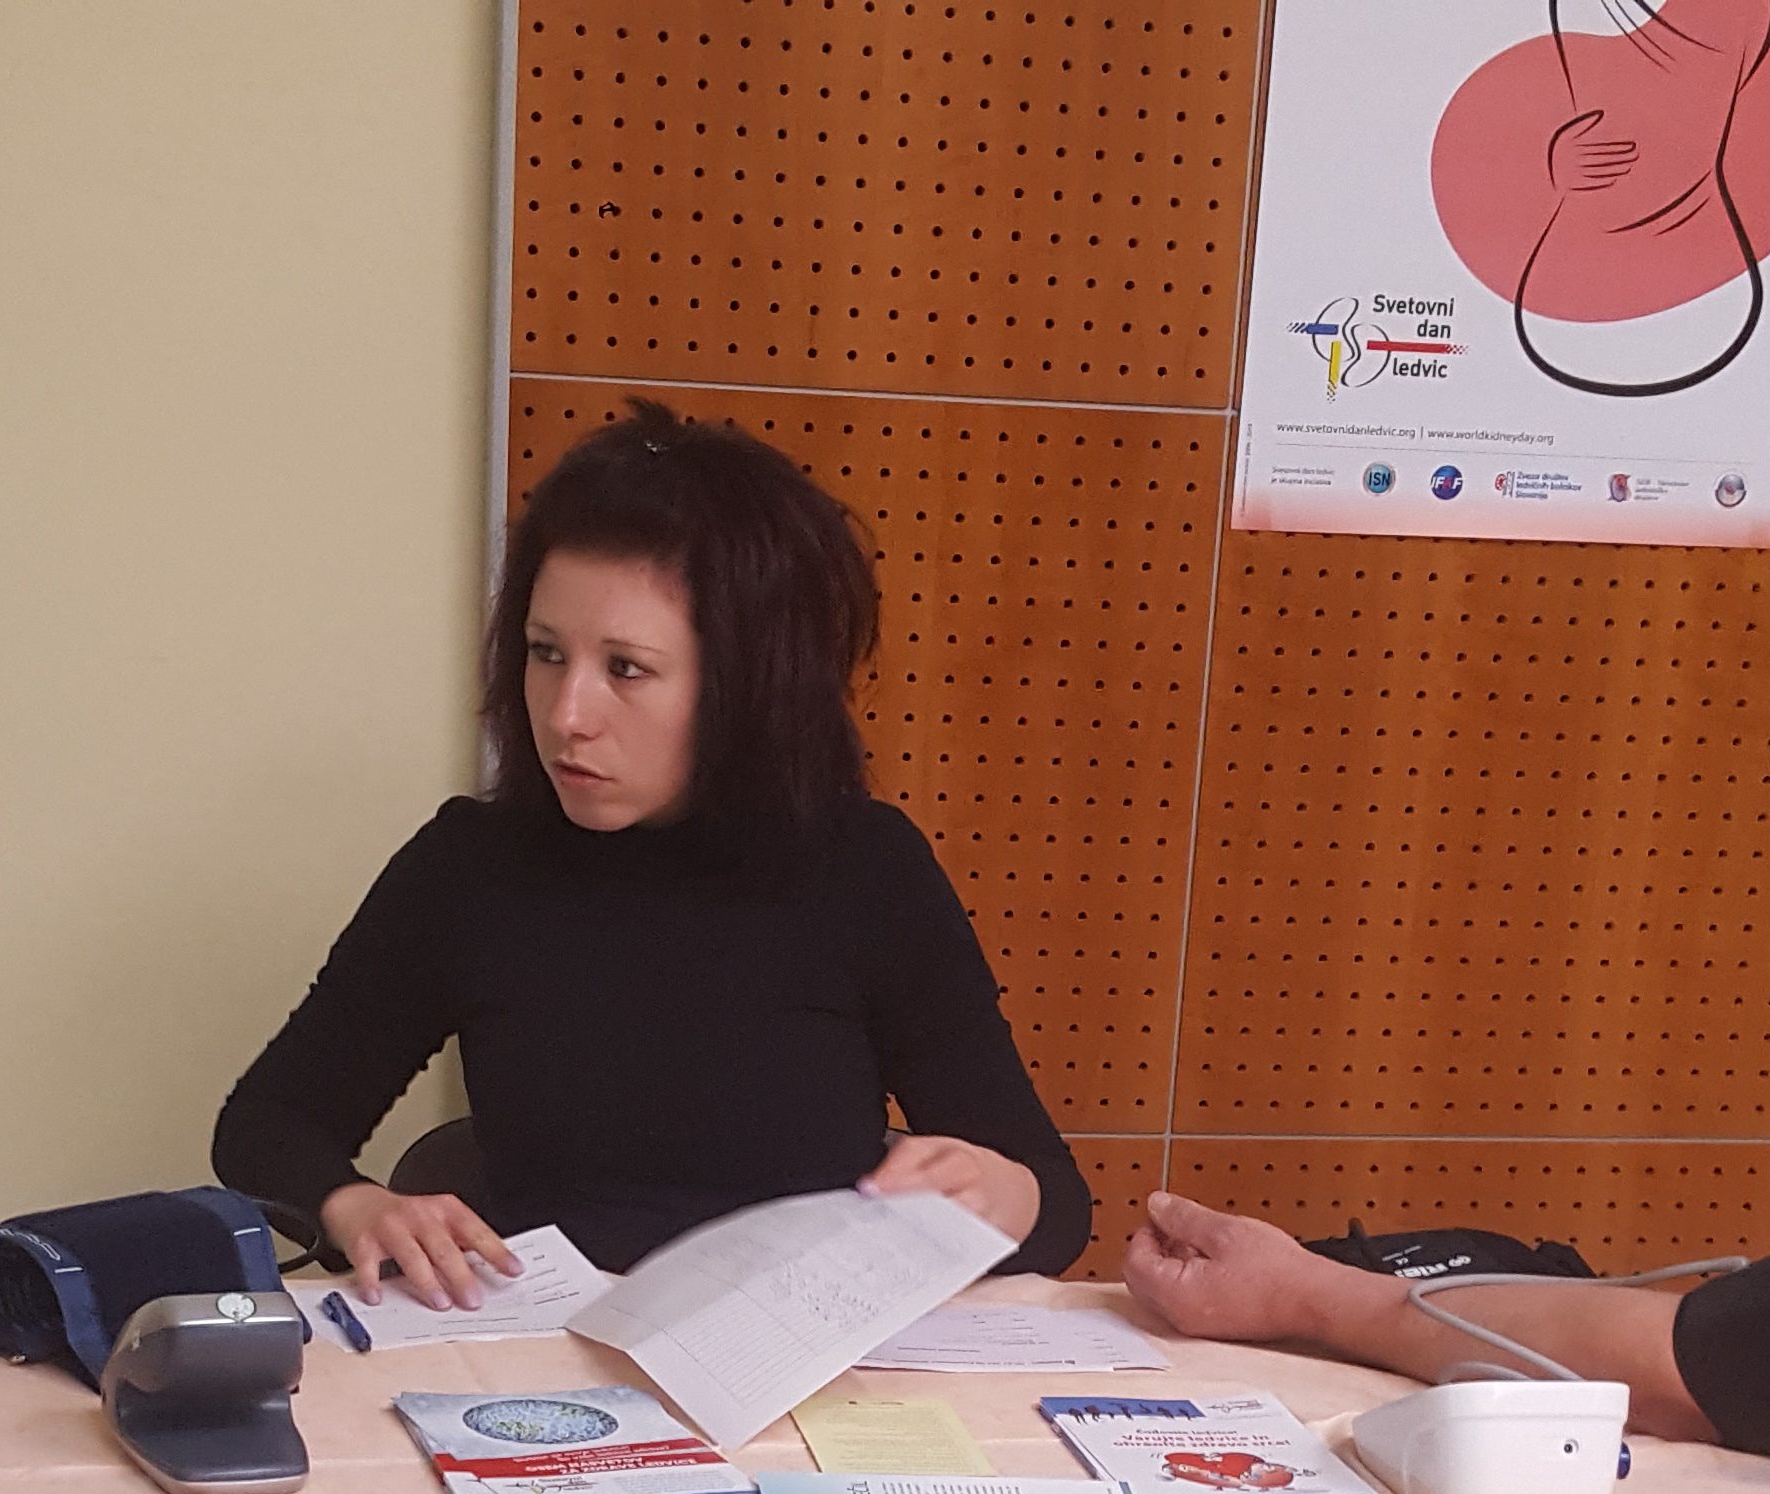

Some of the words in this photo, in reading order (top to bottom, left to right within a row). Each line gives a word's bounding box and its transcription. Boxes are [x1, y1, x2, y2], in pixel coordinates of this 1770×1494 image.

[1373, 294, 1455, 317] Svetovni
[1417, 319, 1451, 338] dan
[1392, 358, 1448, 378] ledvic
[1277, 423, 1416, 439] www.svetovnidanledvic.org
[1427, 429, 1554, 446] www.worldkidneyday.org
[1368, 470, 1391, 487] ISN
